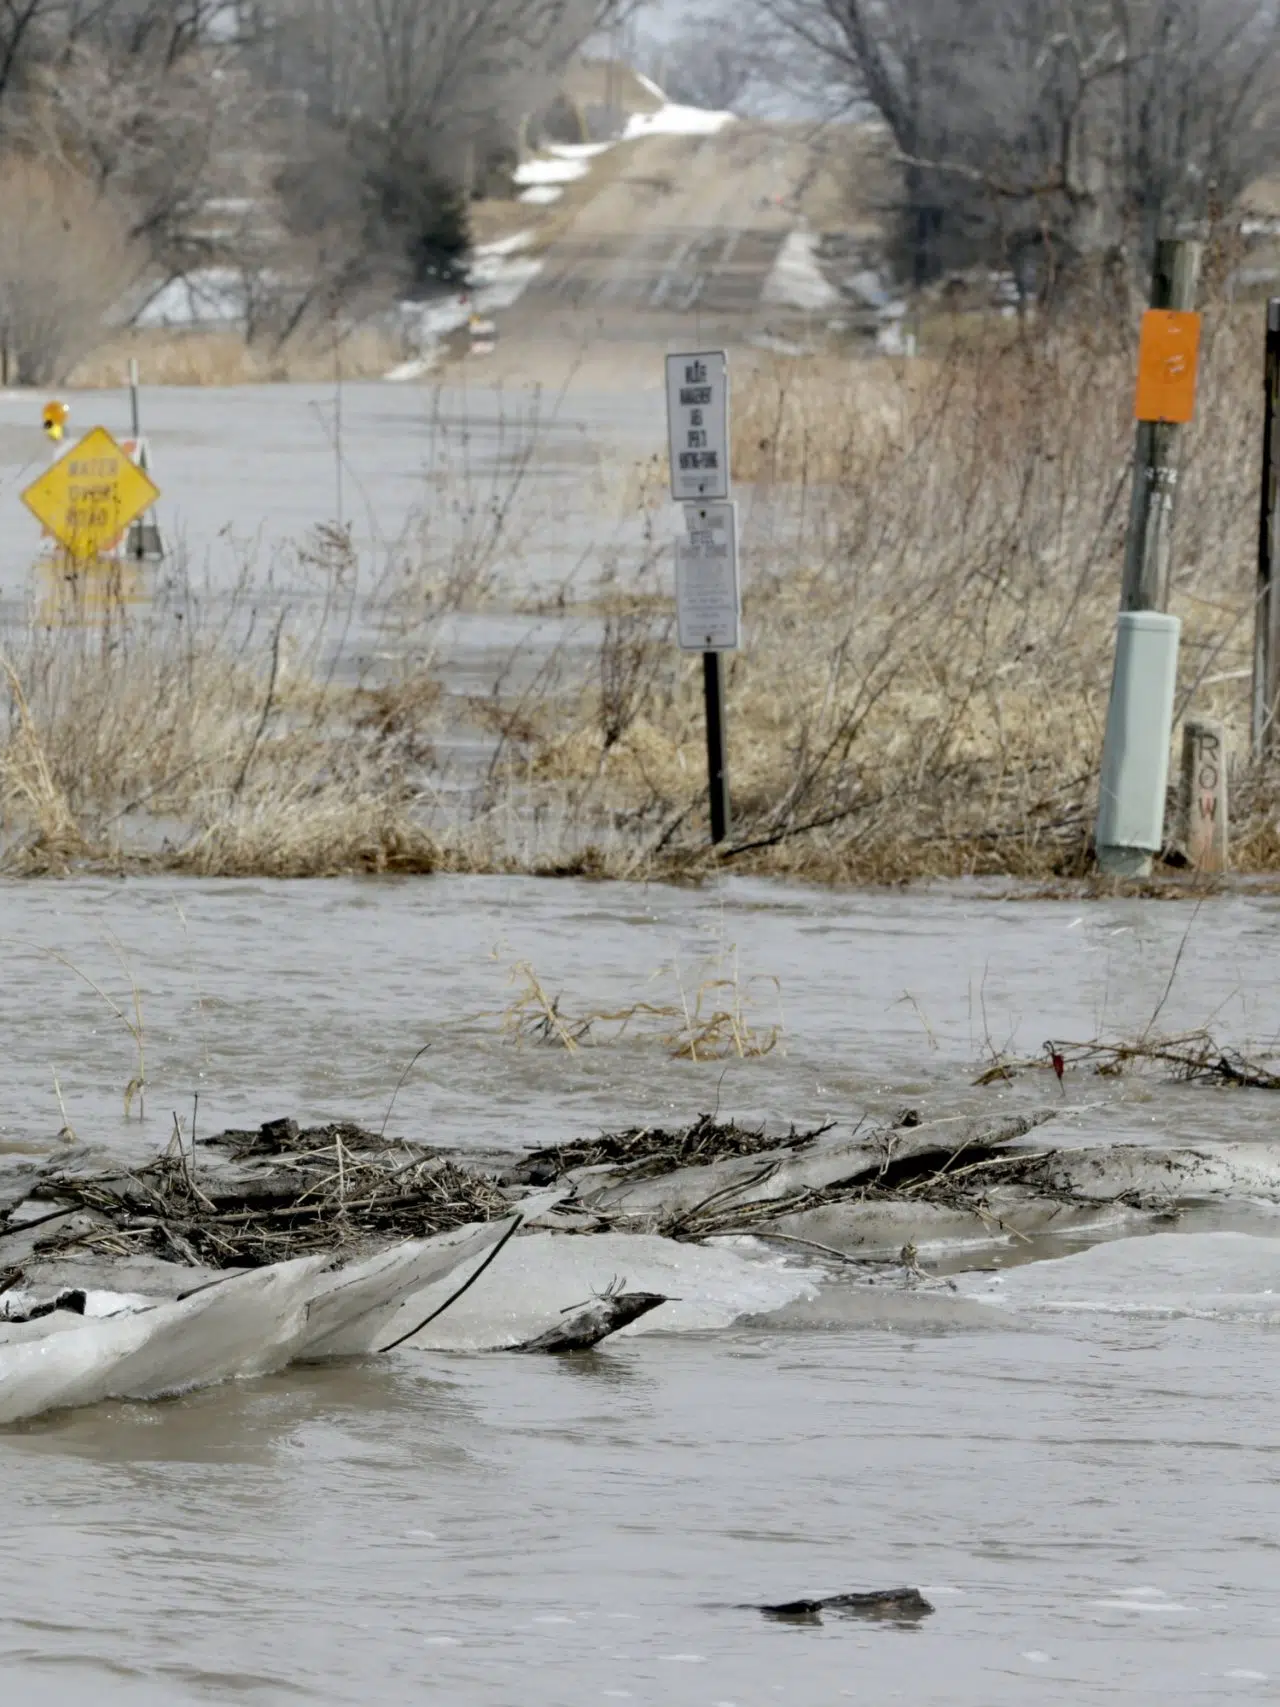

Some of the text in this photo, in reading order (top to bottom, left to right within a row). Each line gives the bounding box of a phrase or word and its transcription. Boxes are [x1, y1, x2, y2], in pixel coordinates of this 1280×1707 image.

[68, 458, 117, 477] WATER
[69, 484, 111, 503] OVER
[67, 507, 108, 528] ROAD
[1194, 733, 1219, 821] ROW
